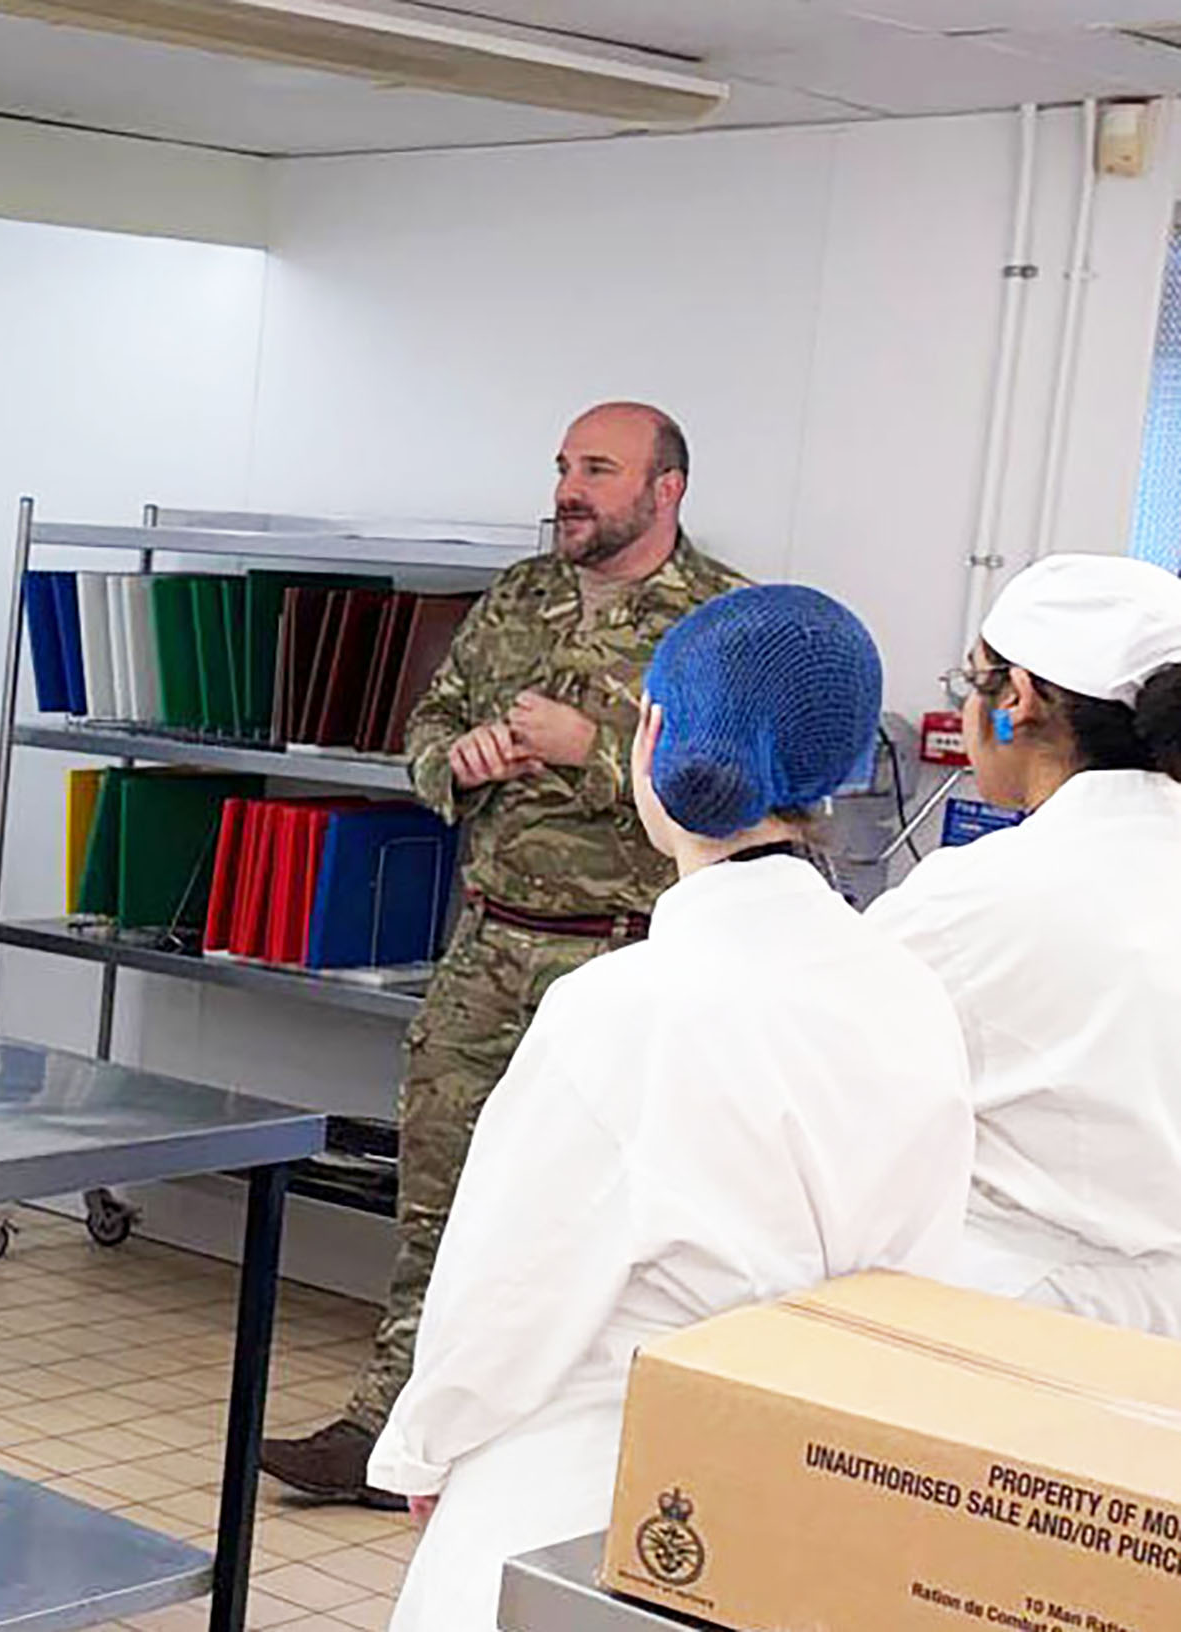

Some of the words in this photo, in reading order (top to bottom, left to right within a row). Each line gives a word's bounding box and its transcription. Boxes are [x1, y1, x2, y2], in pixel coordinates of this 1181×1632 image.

[806, 1443, 961, 1508] UNAUTHORISED
[966, 1490, 1022, 1527] SALE
[1026, 1508, 1112, 1554] AND/OR
[988, 1464, 1103, 1517] PROPERTY
[1107, 1499, 1138, 1527] OF
[1142, 1508, 1181, 1543] MO
[911, 1582, 962, 1610] Ration
[964, 1600, 984, 1618] de
[1047, 1604, 1082, 1628] Man
